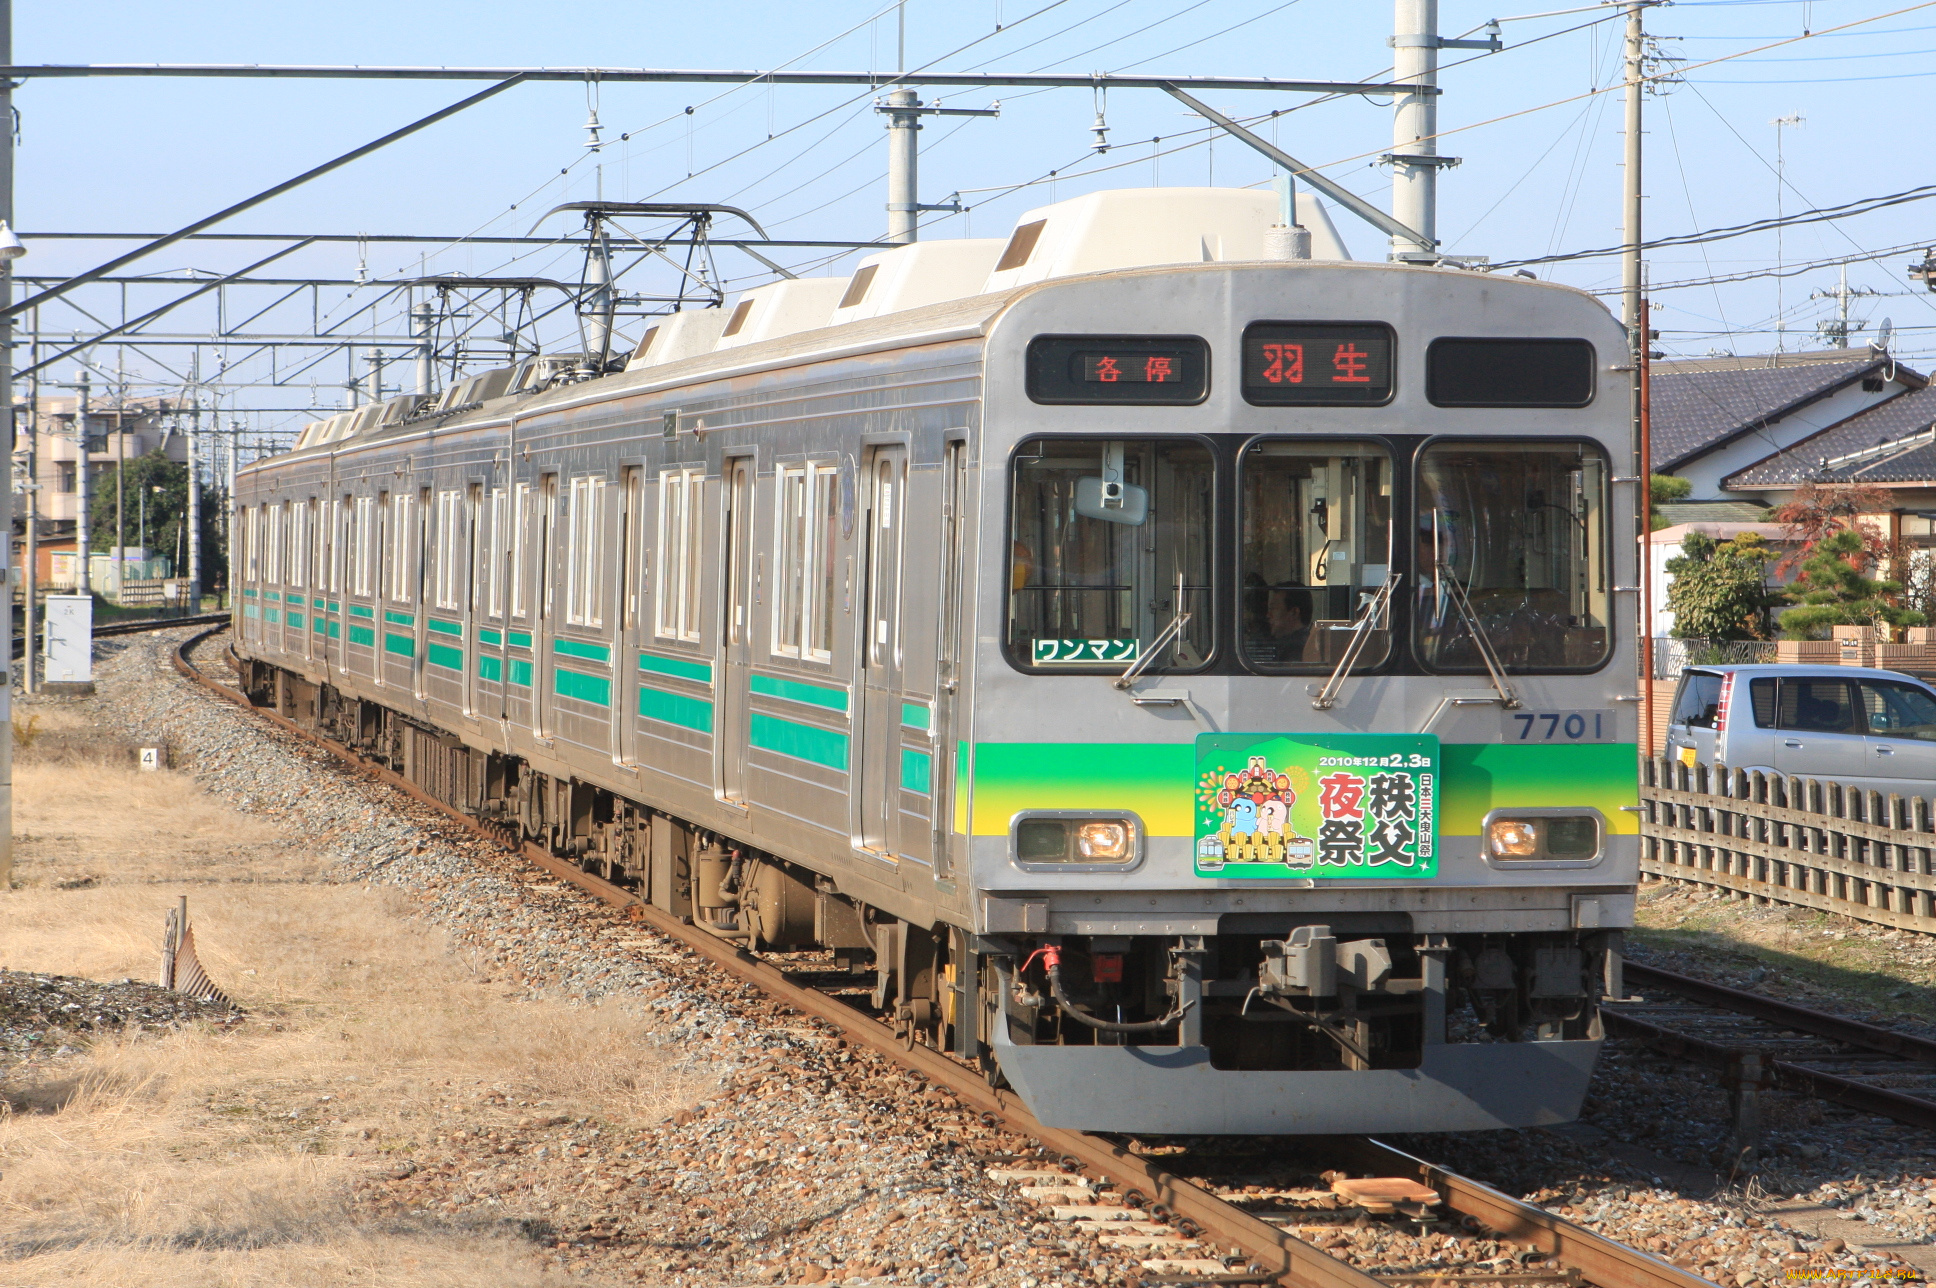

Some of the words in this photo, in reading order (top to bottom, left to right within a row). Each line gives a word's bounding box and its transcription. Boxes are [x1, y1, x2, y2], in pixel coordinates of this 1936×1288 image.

[1095, 356, 1172, 382] 各停
[1262, 343, 1371, 383] 羽生
[1038, 639, 1135, 661] ワンマン
[1514, 713, 1602, 739] 7701
[143, 752, 153, 764] 4
[1317, 771, 1366, 867] 夜祭
[1368, 772, 1416, 867] 秩父
